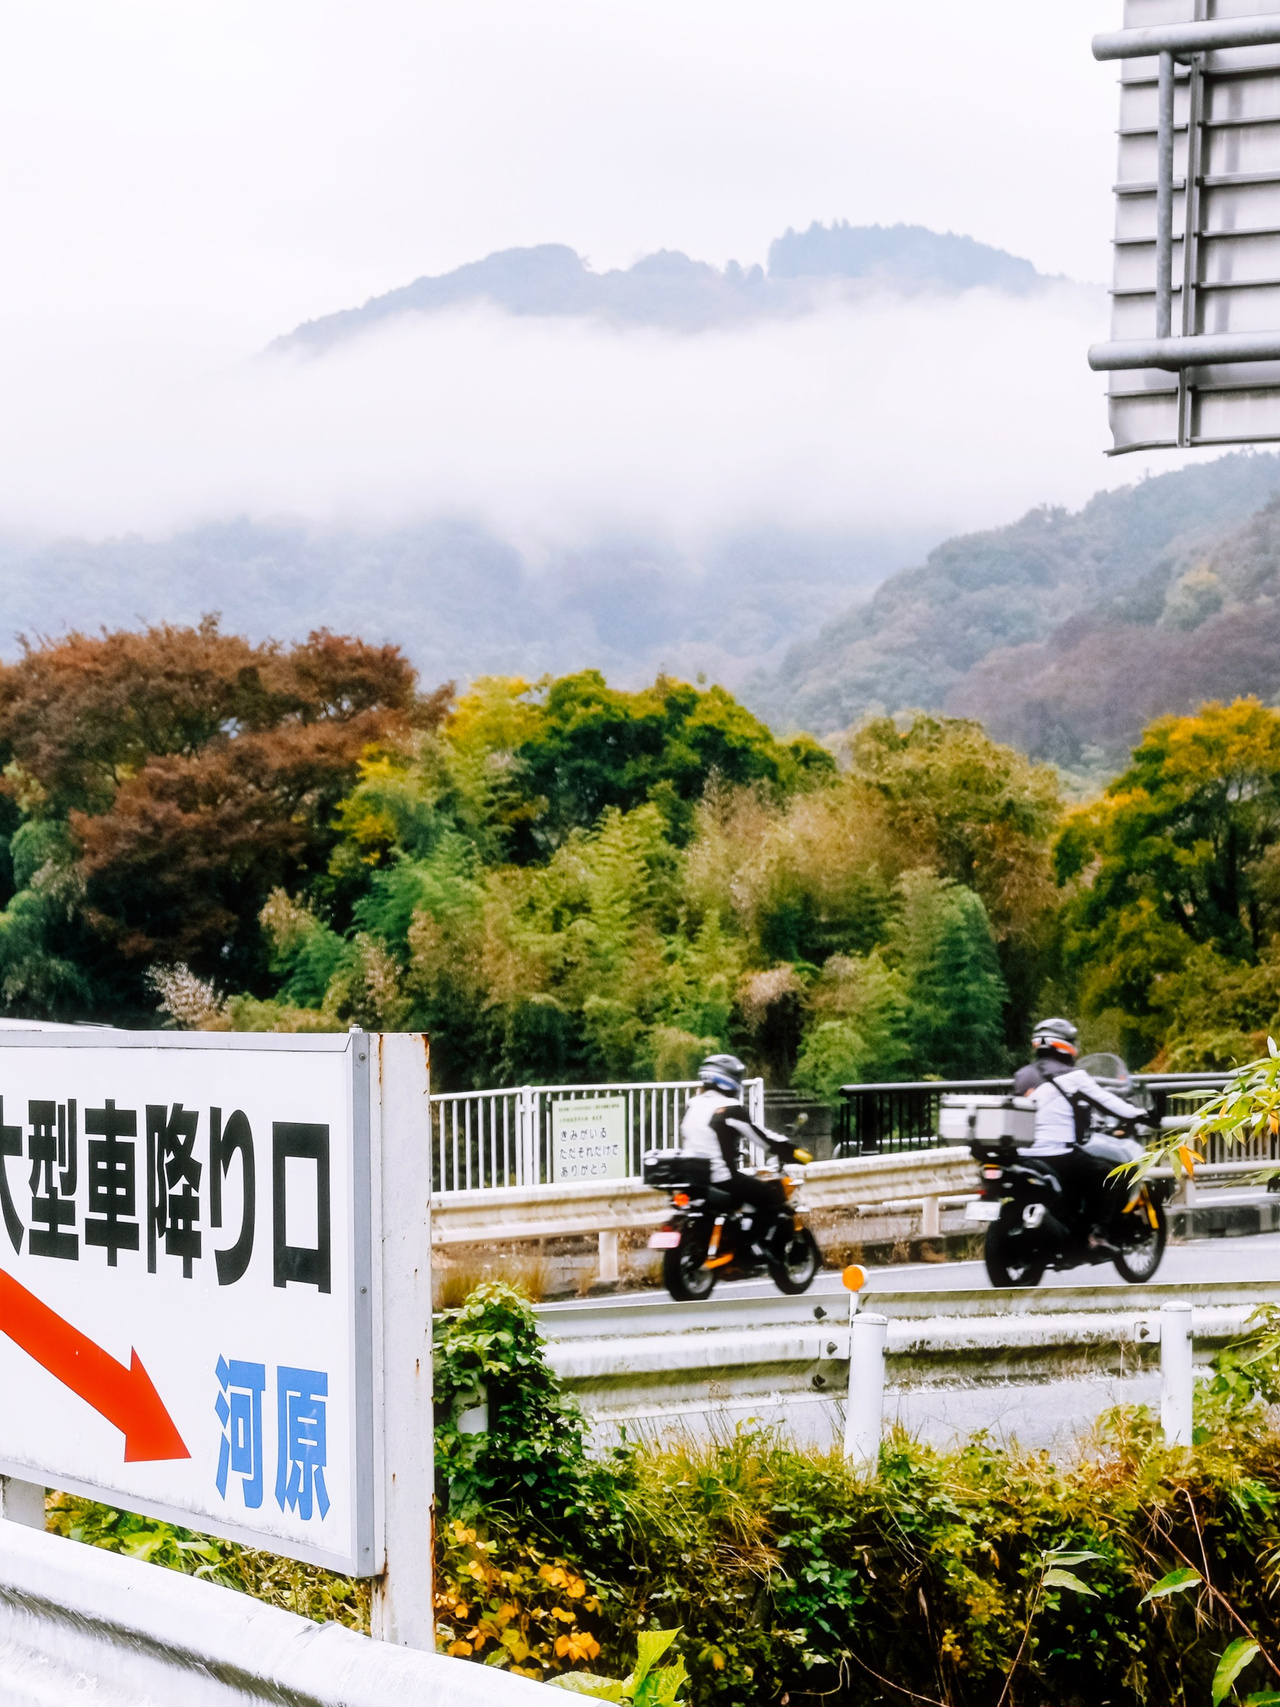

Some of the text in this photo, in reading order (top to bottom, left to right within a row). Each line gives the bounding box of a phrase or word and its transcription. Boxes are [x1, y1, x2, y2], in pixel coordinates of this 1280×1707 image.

[561, 1127, 607, 1142] きみがいる
[560, 1144, 618, 1160] ただそれだけで
[560, 1162, 607, 1178] ありがとう
[214, 1353, 331, 1522] 河原
